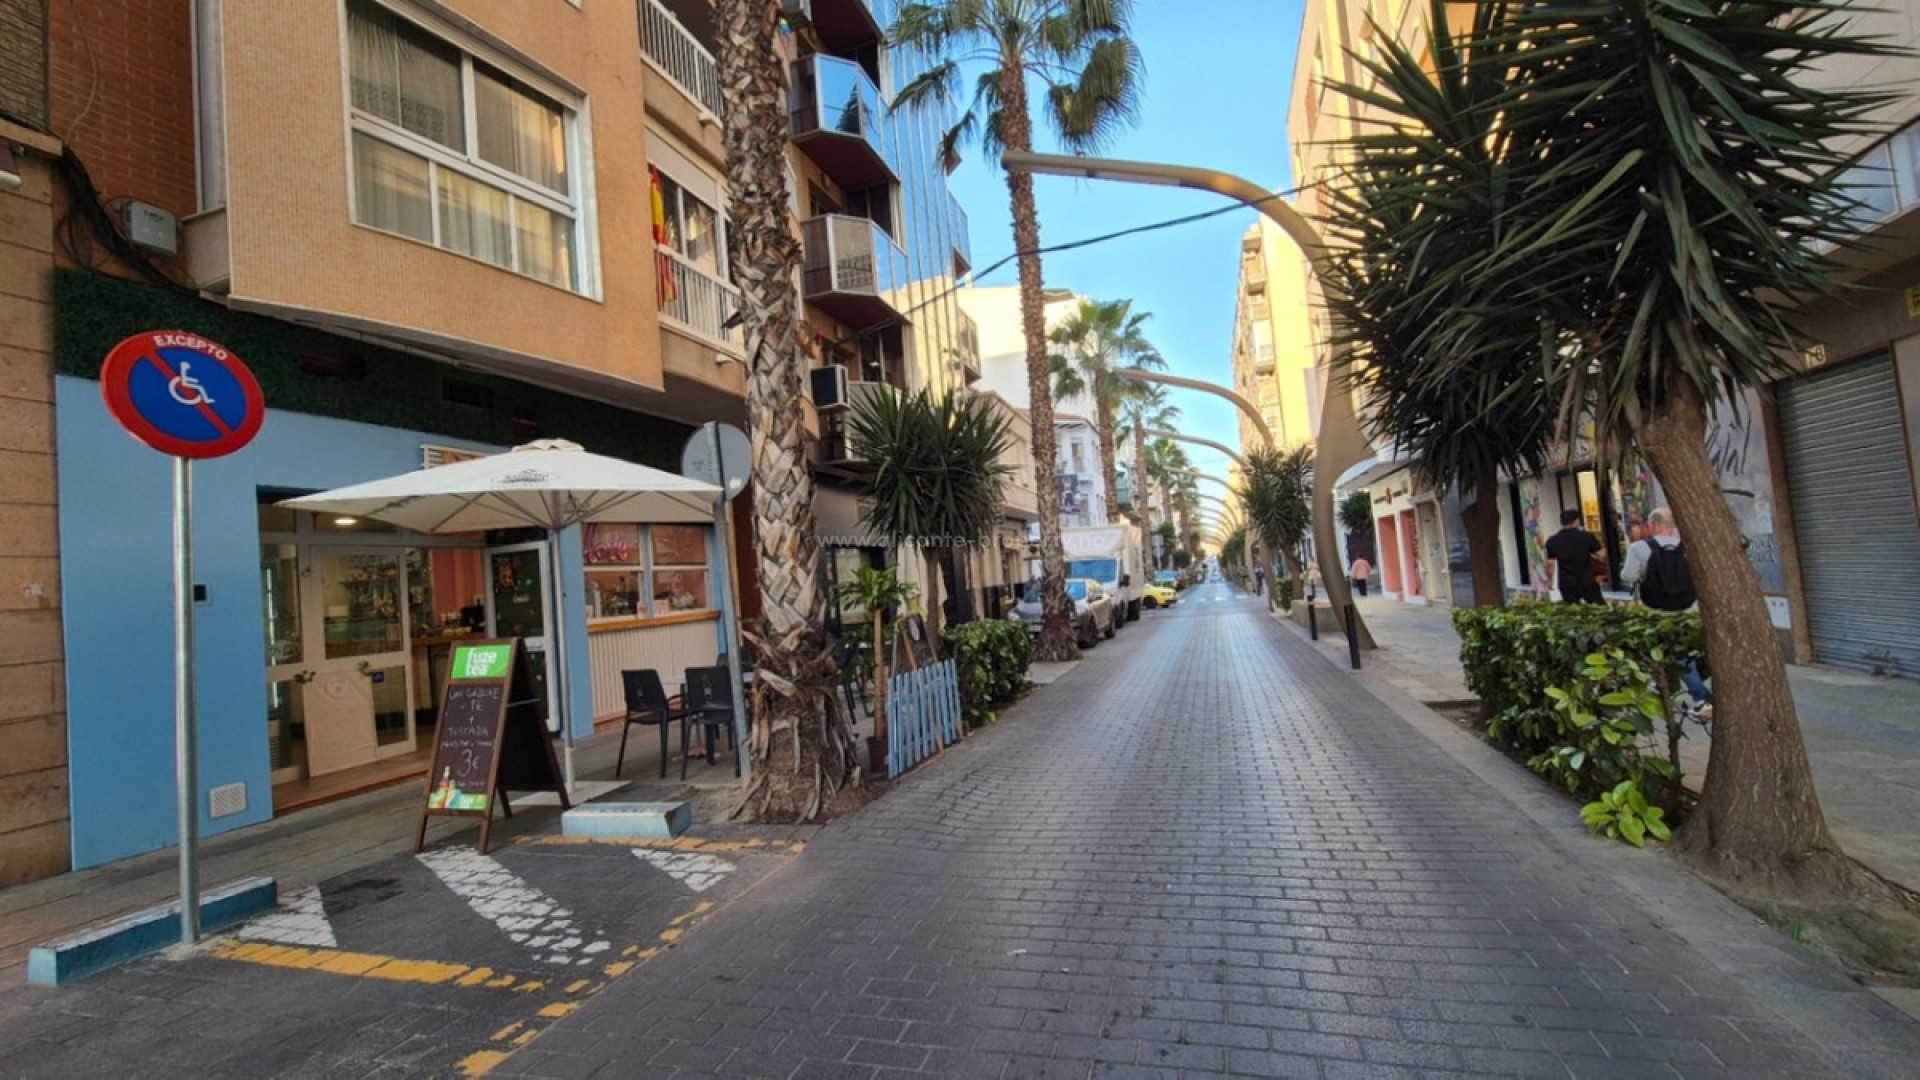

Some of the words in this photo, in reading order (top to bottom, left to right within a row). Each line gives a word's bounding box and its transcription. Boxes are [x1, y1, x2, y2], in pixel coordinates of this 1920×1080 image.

[152, 335, 228, 360] EXCEPTO
[466, 647, 497, 664] fuze
[465, 664, 488, 676] tea
